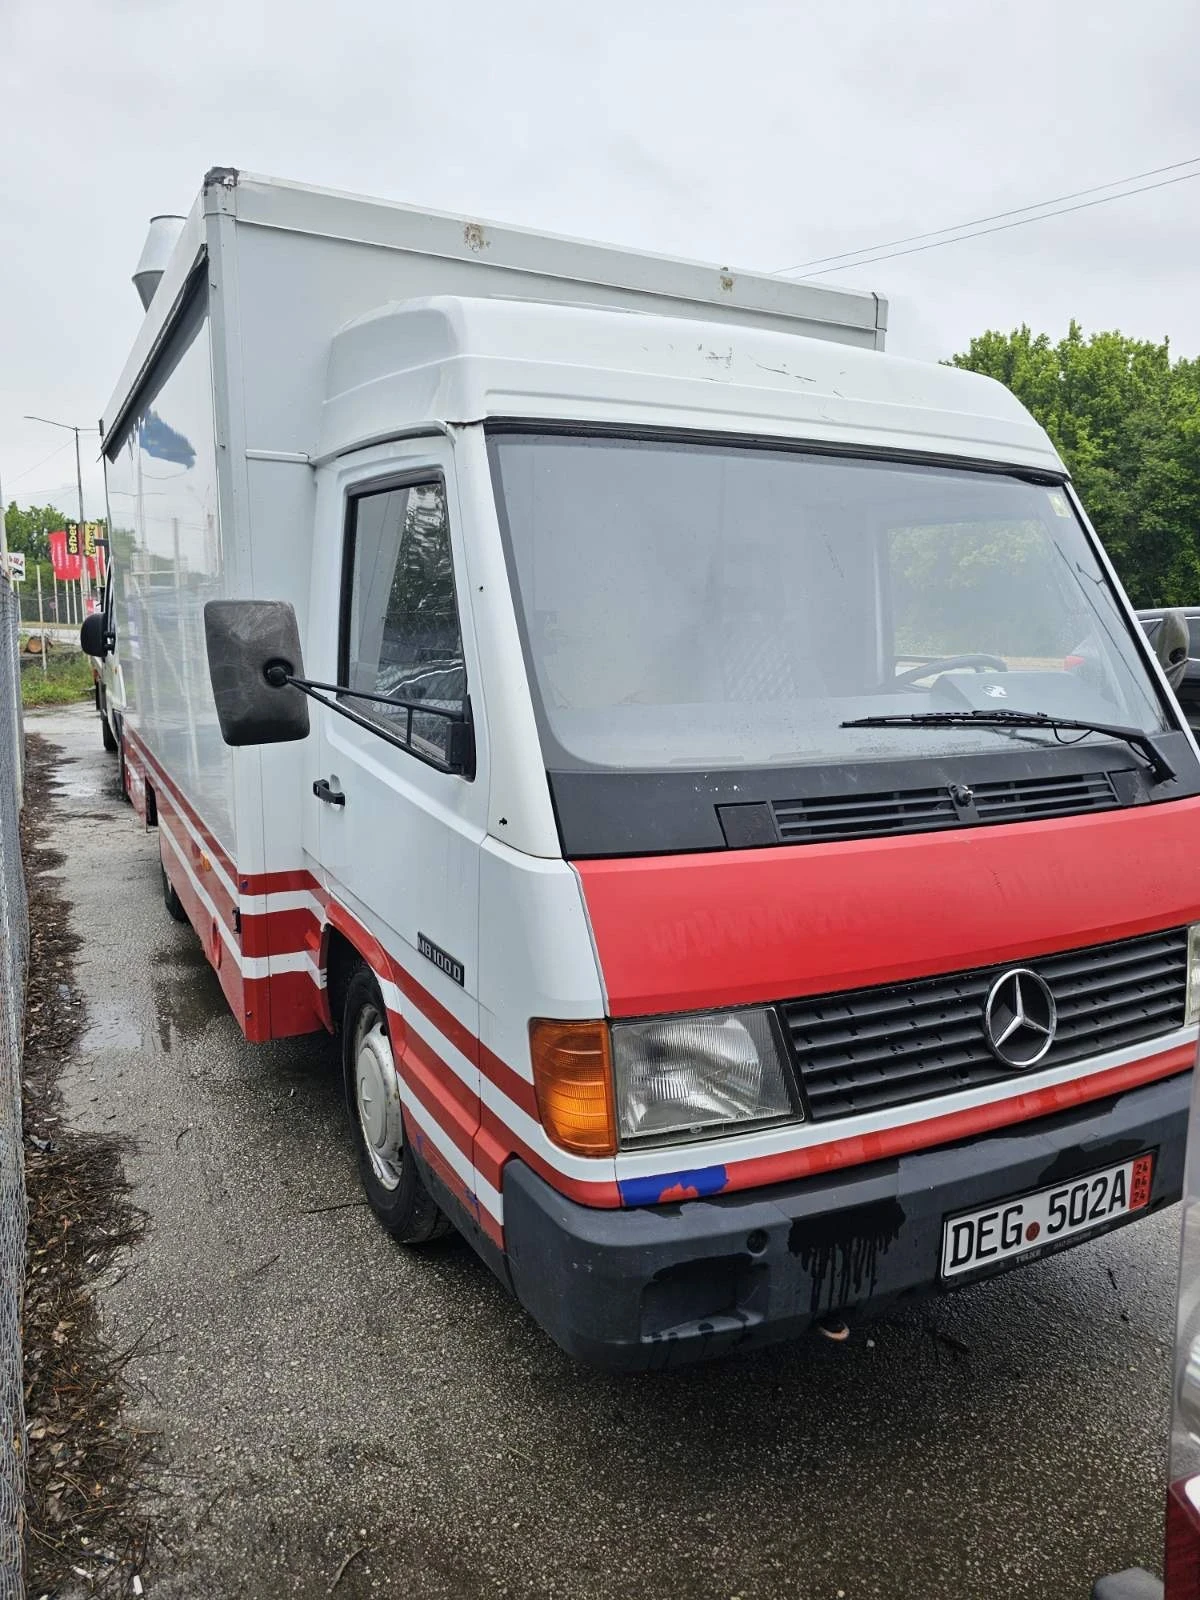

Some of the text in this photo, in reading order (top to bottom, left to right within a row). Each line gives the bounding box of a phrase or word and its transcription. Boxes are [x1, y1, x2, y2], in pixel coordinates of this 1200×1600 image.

[68, 524, 78, 554] efbet
[433, 948, 451, 974] 100
[949, 1204, 1024, 1268] DEG
[1047, 1169, 1127, 1234] 502A
